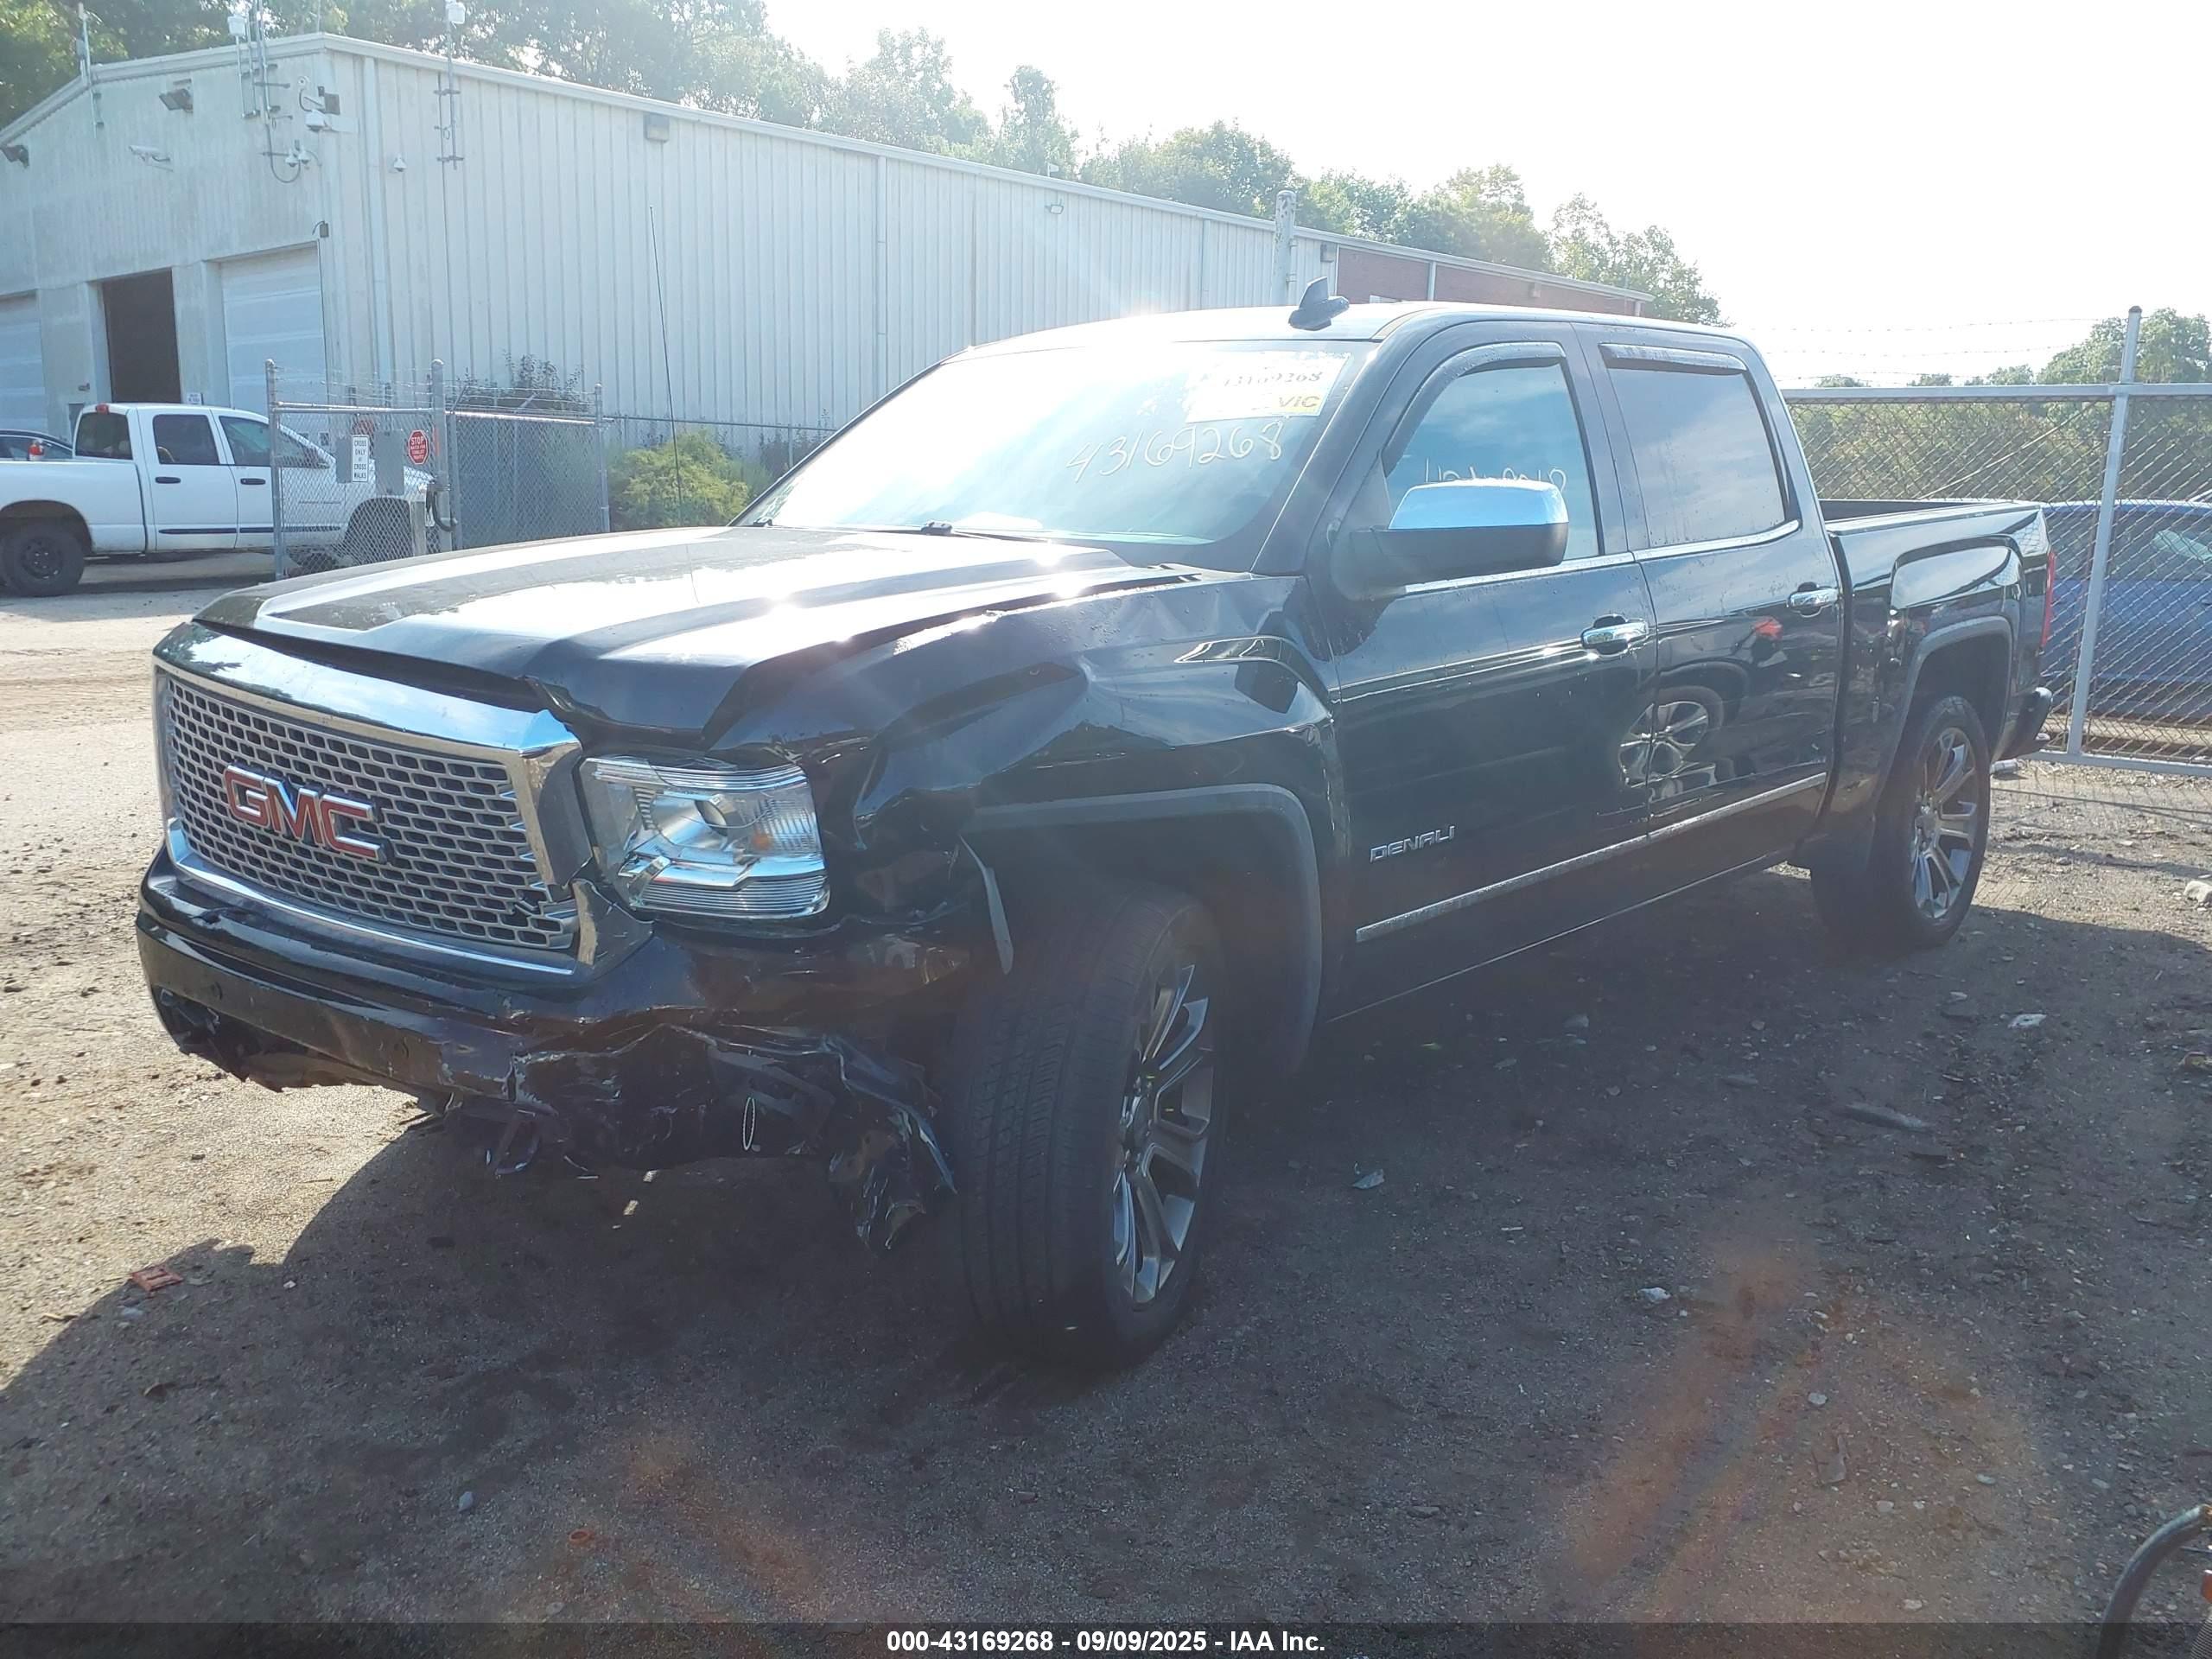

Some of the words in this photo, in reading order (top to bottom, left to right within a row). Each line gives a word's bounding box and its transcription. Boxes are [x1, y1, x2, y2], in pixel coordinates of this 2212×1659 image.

[1278, 395, 1320, 408] VIC
[410, 436, 424, 445] STOP
[1065, 419, 1284, 483] 43169268
[225, 765, 381, 861] GMC
[1370, 825, 1455, 863] DENALI
